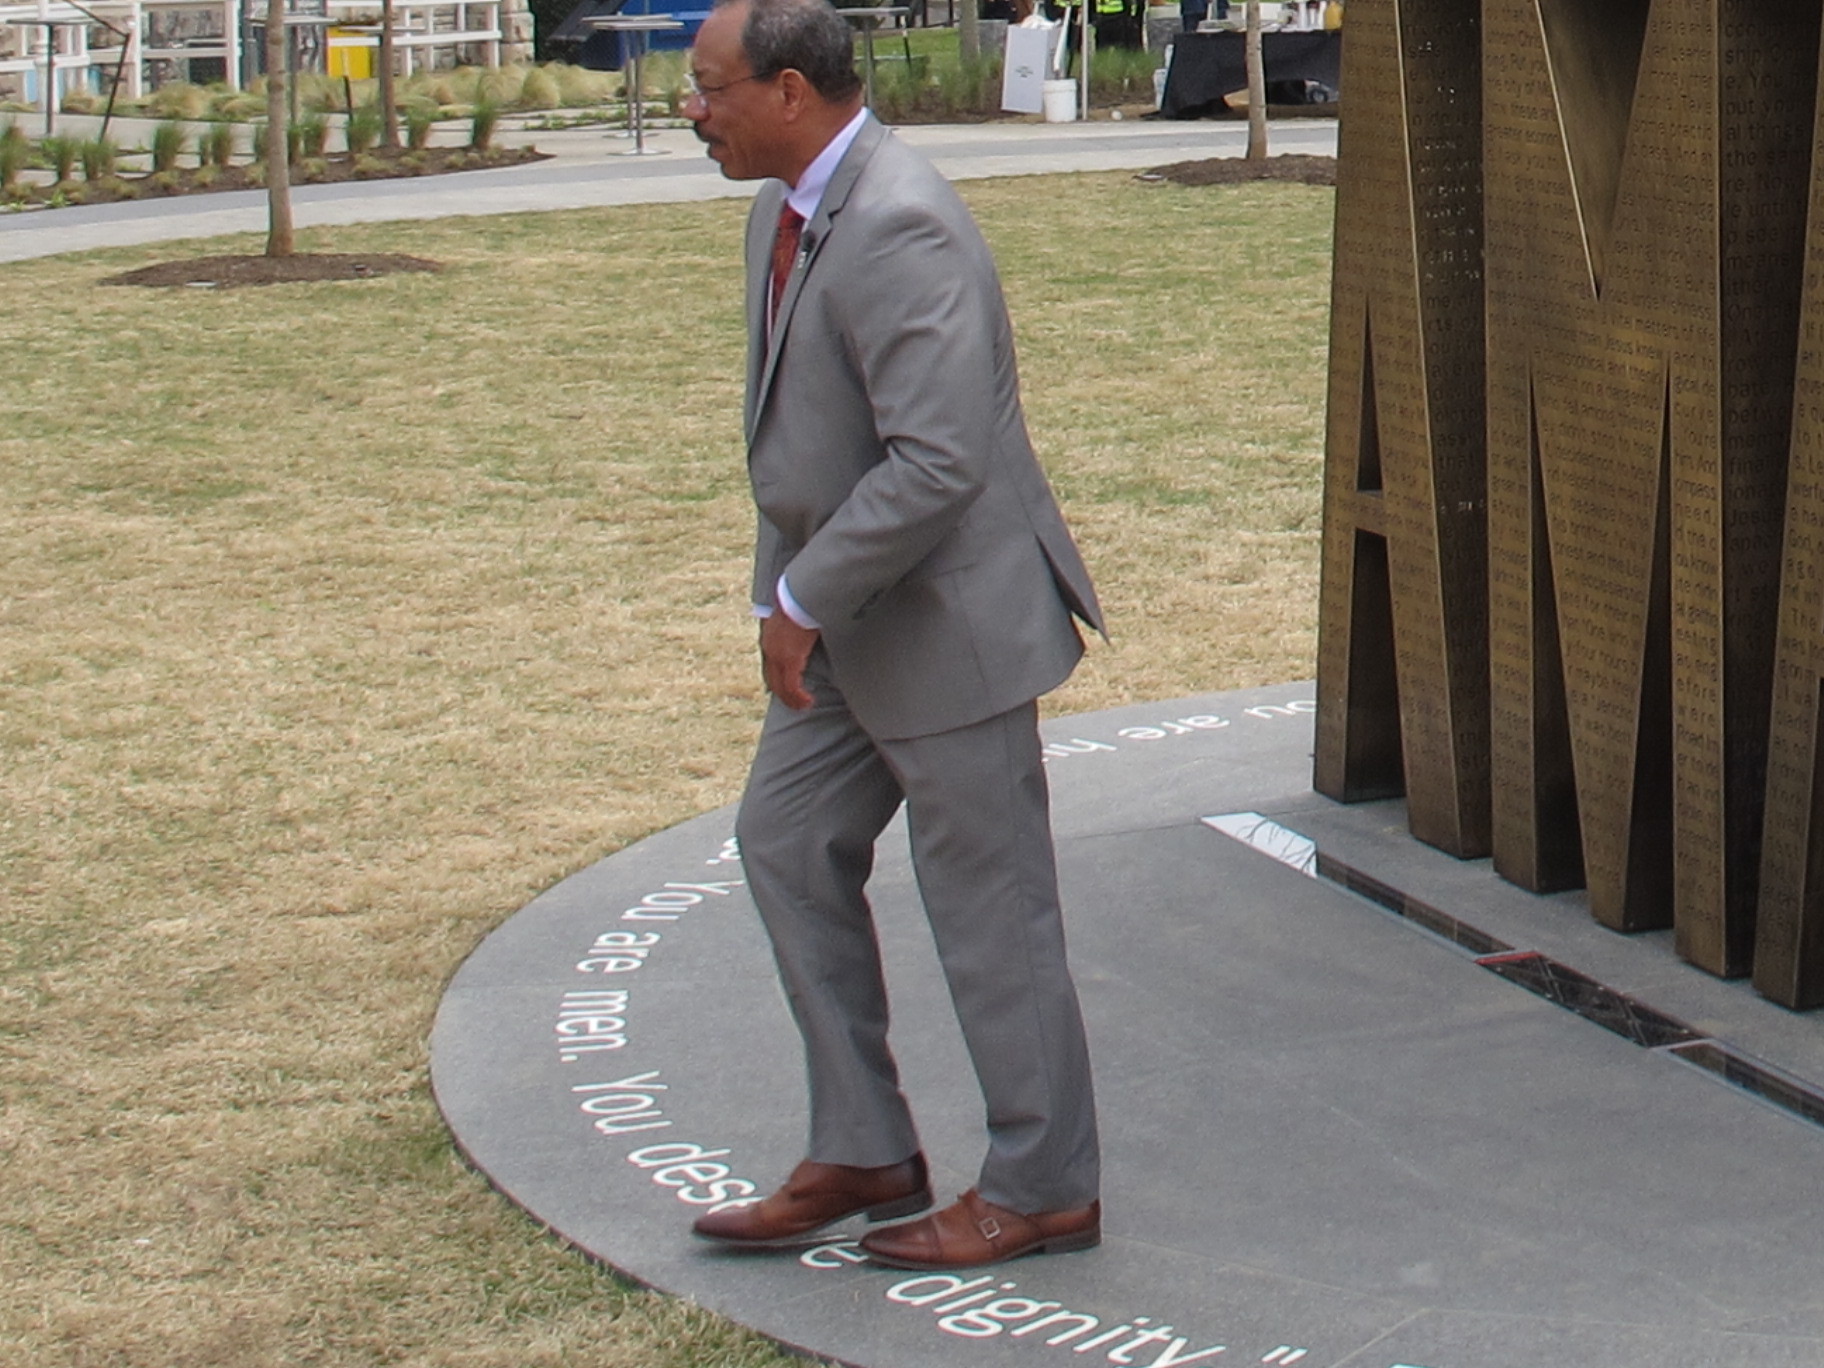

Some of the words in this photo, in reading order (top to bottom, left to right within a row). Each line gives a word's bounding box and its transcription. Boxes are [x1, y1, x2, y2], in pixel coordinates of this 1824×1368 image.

[621, 879, 746, 921] You
[576, 930, 661, 974] are
[555, 989, 629, 1064] men.
[570, 1070, 674, 1135] You
